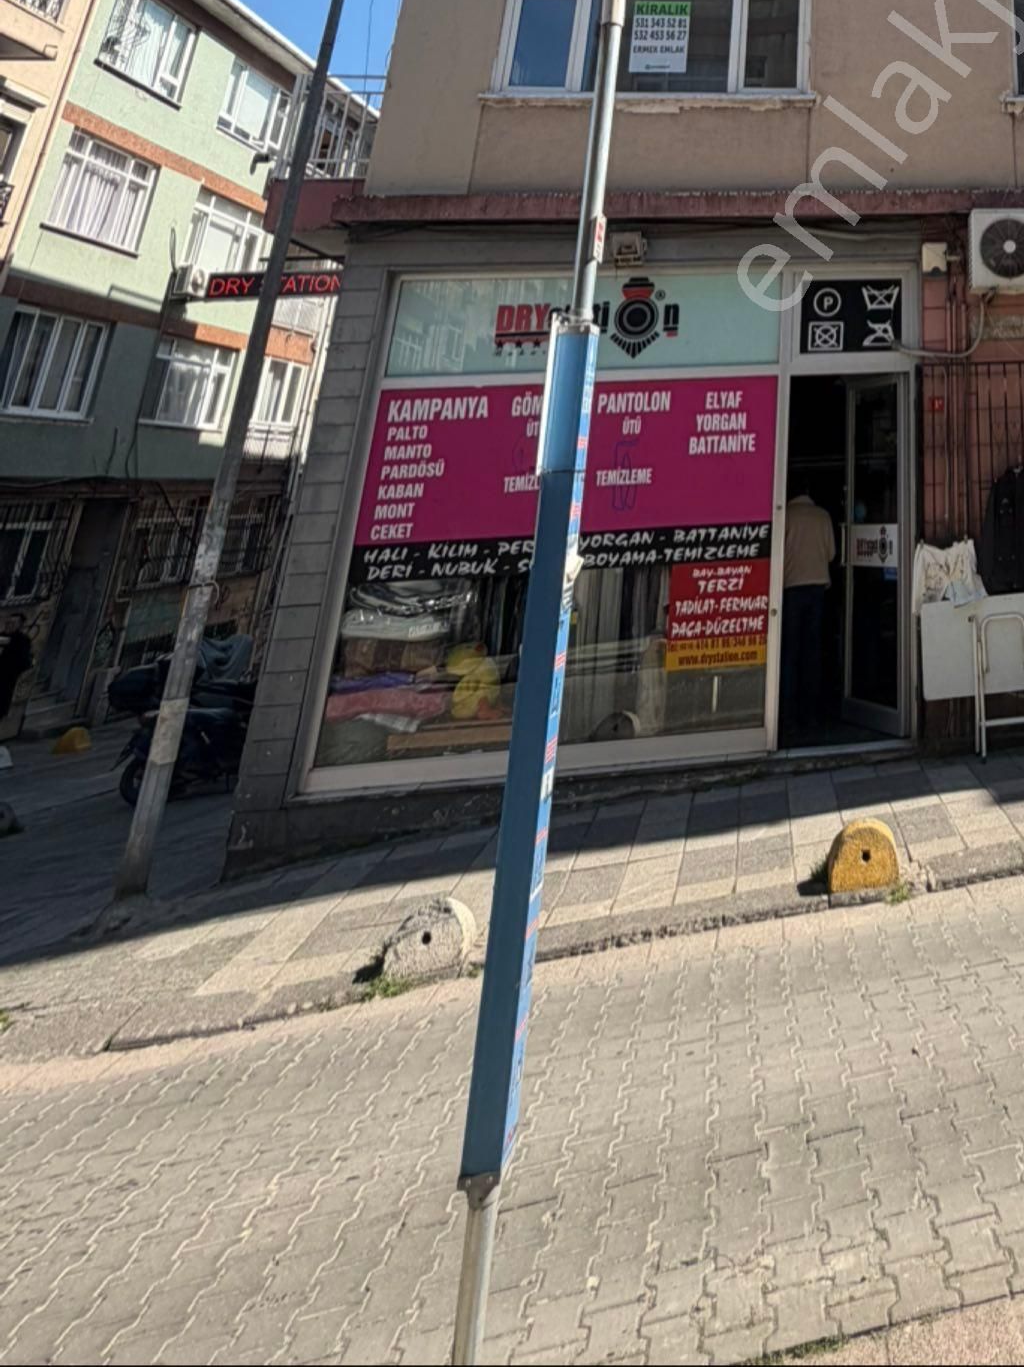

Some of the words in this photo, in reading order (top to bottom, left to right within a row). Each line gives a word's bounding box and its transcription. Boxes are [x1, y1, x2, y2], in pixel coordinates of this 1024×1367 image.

[636, 2, 688, 15] KİRALIK
[208, 277, 255, 296] DRY
[263, 274, 341, 293] ATION
[387, 395, 489, 423] KAMPANYA
[511, 391, 544, 417] GÖM
[597, 390, 672, 414] PANTOLON
[705, 390, 743, 411] ELYAF
[386, 424, 428, 442] PALTO
[526, 418, 539, 437] ÜT
[621, 416, 642, 435] ÜTÜ
[696, 412, 747, 433] YORGAN
[383, 443, 432, 461] MANTO
[688, 431, 756, 456] BATTANİYE
[380, 457, 445, 481] PARDÖSÜ
[595, 466, 653, 487] TEMİZLEME
[377, 482, 425, 501] KABAN
[503, 472, 541, 494] TEMİZL
[374, 502, 416, 520] MONT
[370, 522, 414, 541] CEKET
[363, 546, 409, 565] HALI
[497, 539, 536, 557] PER
[579, 530, 655, 551] YORGAN
[366, 562, 414, 581] DERİ
[430, 557, 499, 577] NUBUK
[697, 574, 745, 595] TERZİ
